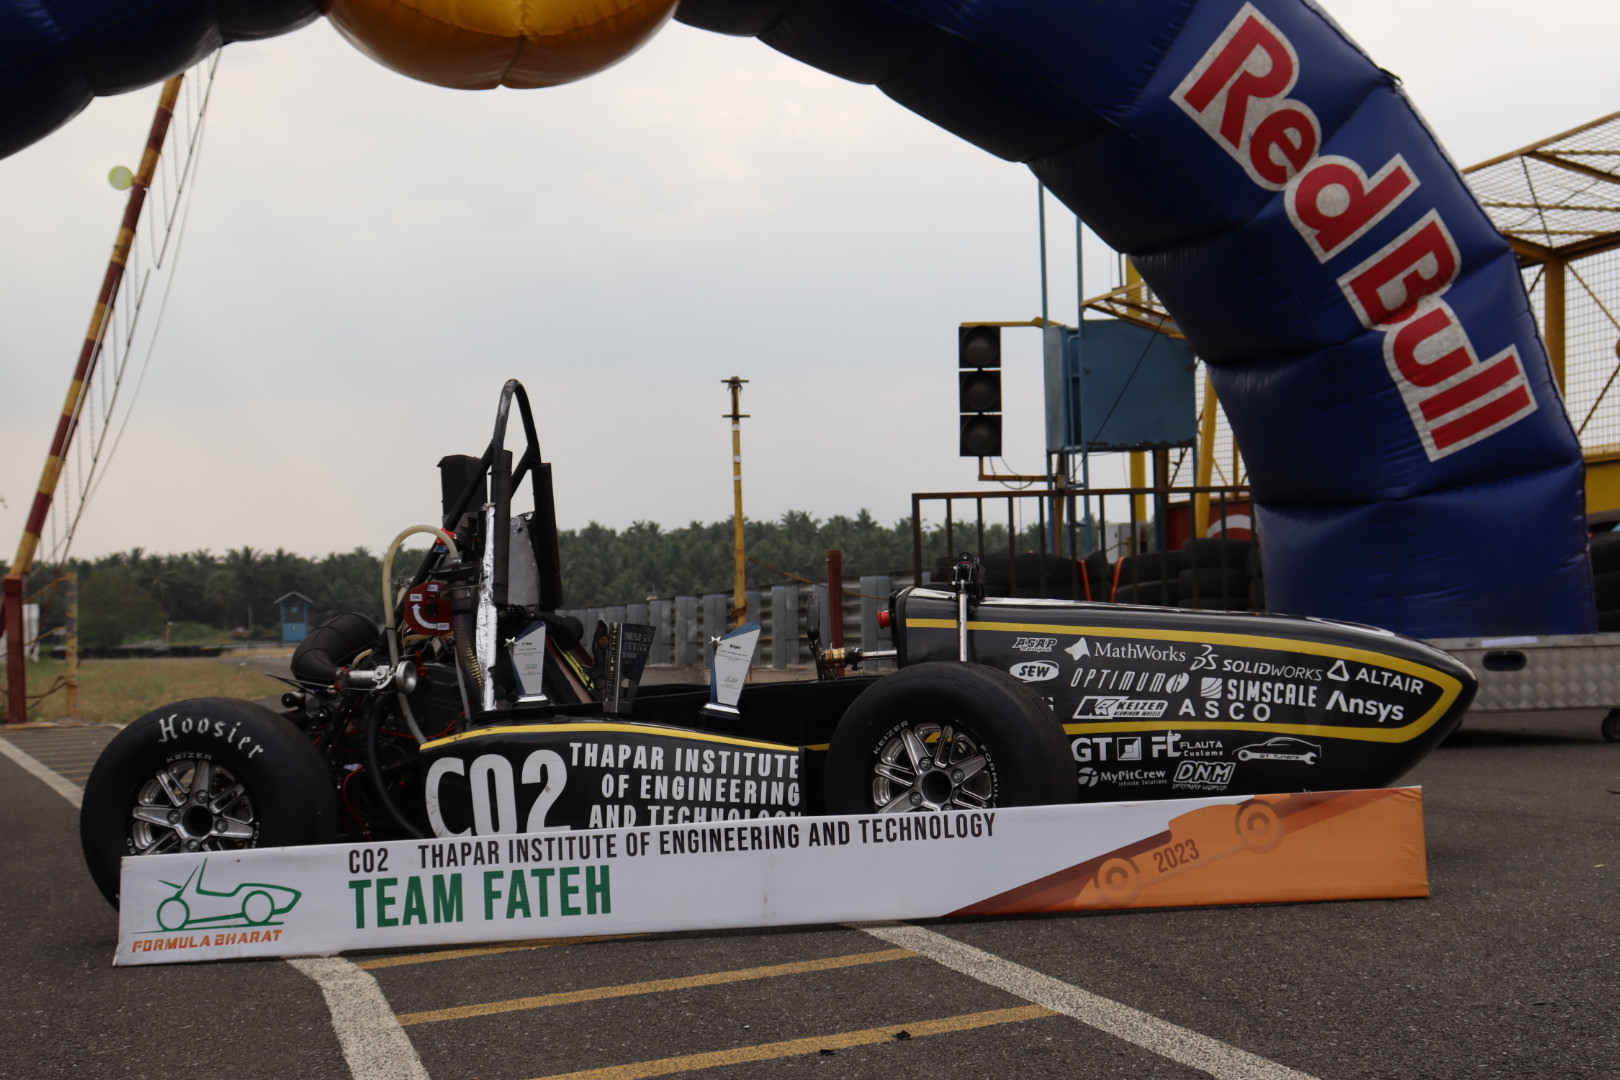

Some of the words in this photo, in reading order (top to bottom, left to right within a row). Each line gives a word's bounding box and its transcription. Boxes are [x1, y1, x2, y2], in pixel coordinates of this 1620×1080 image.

[1176, 8, 1416, 260] Red
[1343, 213, 1535, 457] Bull
[1013, 637, 1057, 649] ASAP
[1094, 642, 1186, 662] MathWorks
[1018, 665, 1050, 678] SEW
[1222, 659, 1323, 681] SOLIDWORKS
[1355, 667, 1424, 695] ALTAIR
[1116, 701, 1166, 711] KEIZER
[1227, 678, 1318, 708] SIMSCALE
[1325, 690, 1404, 723] Ansys
[158, 714, 264, 758] Hoosier
[873, 720, 909, 754] KEIZER
[1180, 740, 1223, 749] FLAUTA
[570, 742, 664, 770] THAPAR
[674, 748, 799, 778] INSTITUTE
[1071, 737, 1112, 762] GT
[1100, 770, 1166, 784] MyPitCrew
[1175, 761, 1235, 783] DNM
[602, 774, 630, 798] OF
[640, 775, 800, 807] ENGINEERING
[588, 804, 637, 828] AND
[418, 840, 500, 869] THAPAR
[508, 834, 617, 864] INSTITUTE
[626, 832, 650, 857] OF
[660, 823, 800, 855] ENGINEERING
[808, 820, 850, 847] AND
[858, 812, 996, 844] TECHNOLOGY
[1152, 838, 1200, 874] 2023
[348, 872, 464, 930] TEAM
[484, 864, 612, 921] FATEH
[132, 934, 210, 953] FORMULA
[214, 929, 282, 946] BHARAT
